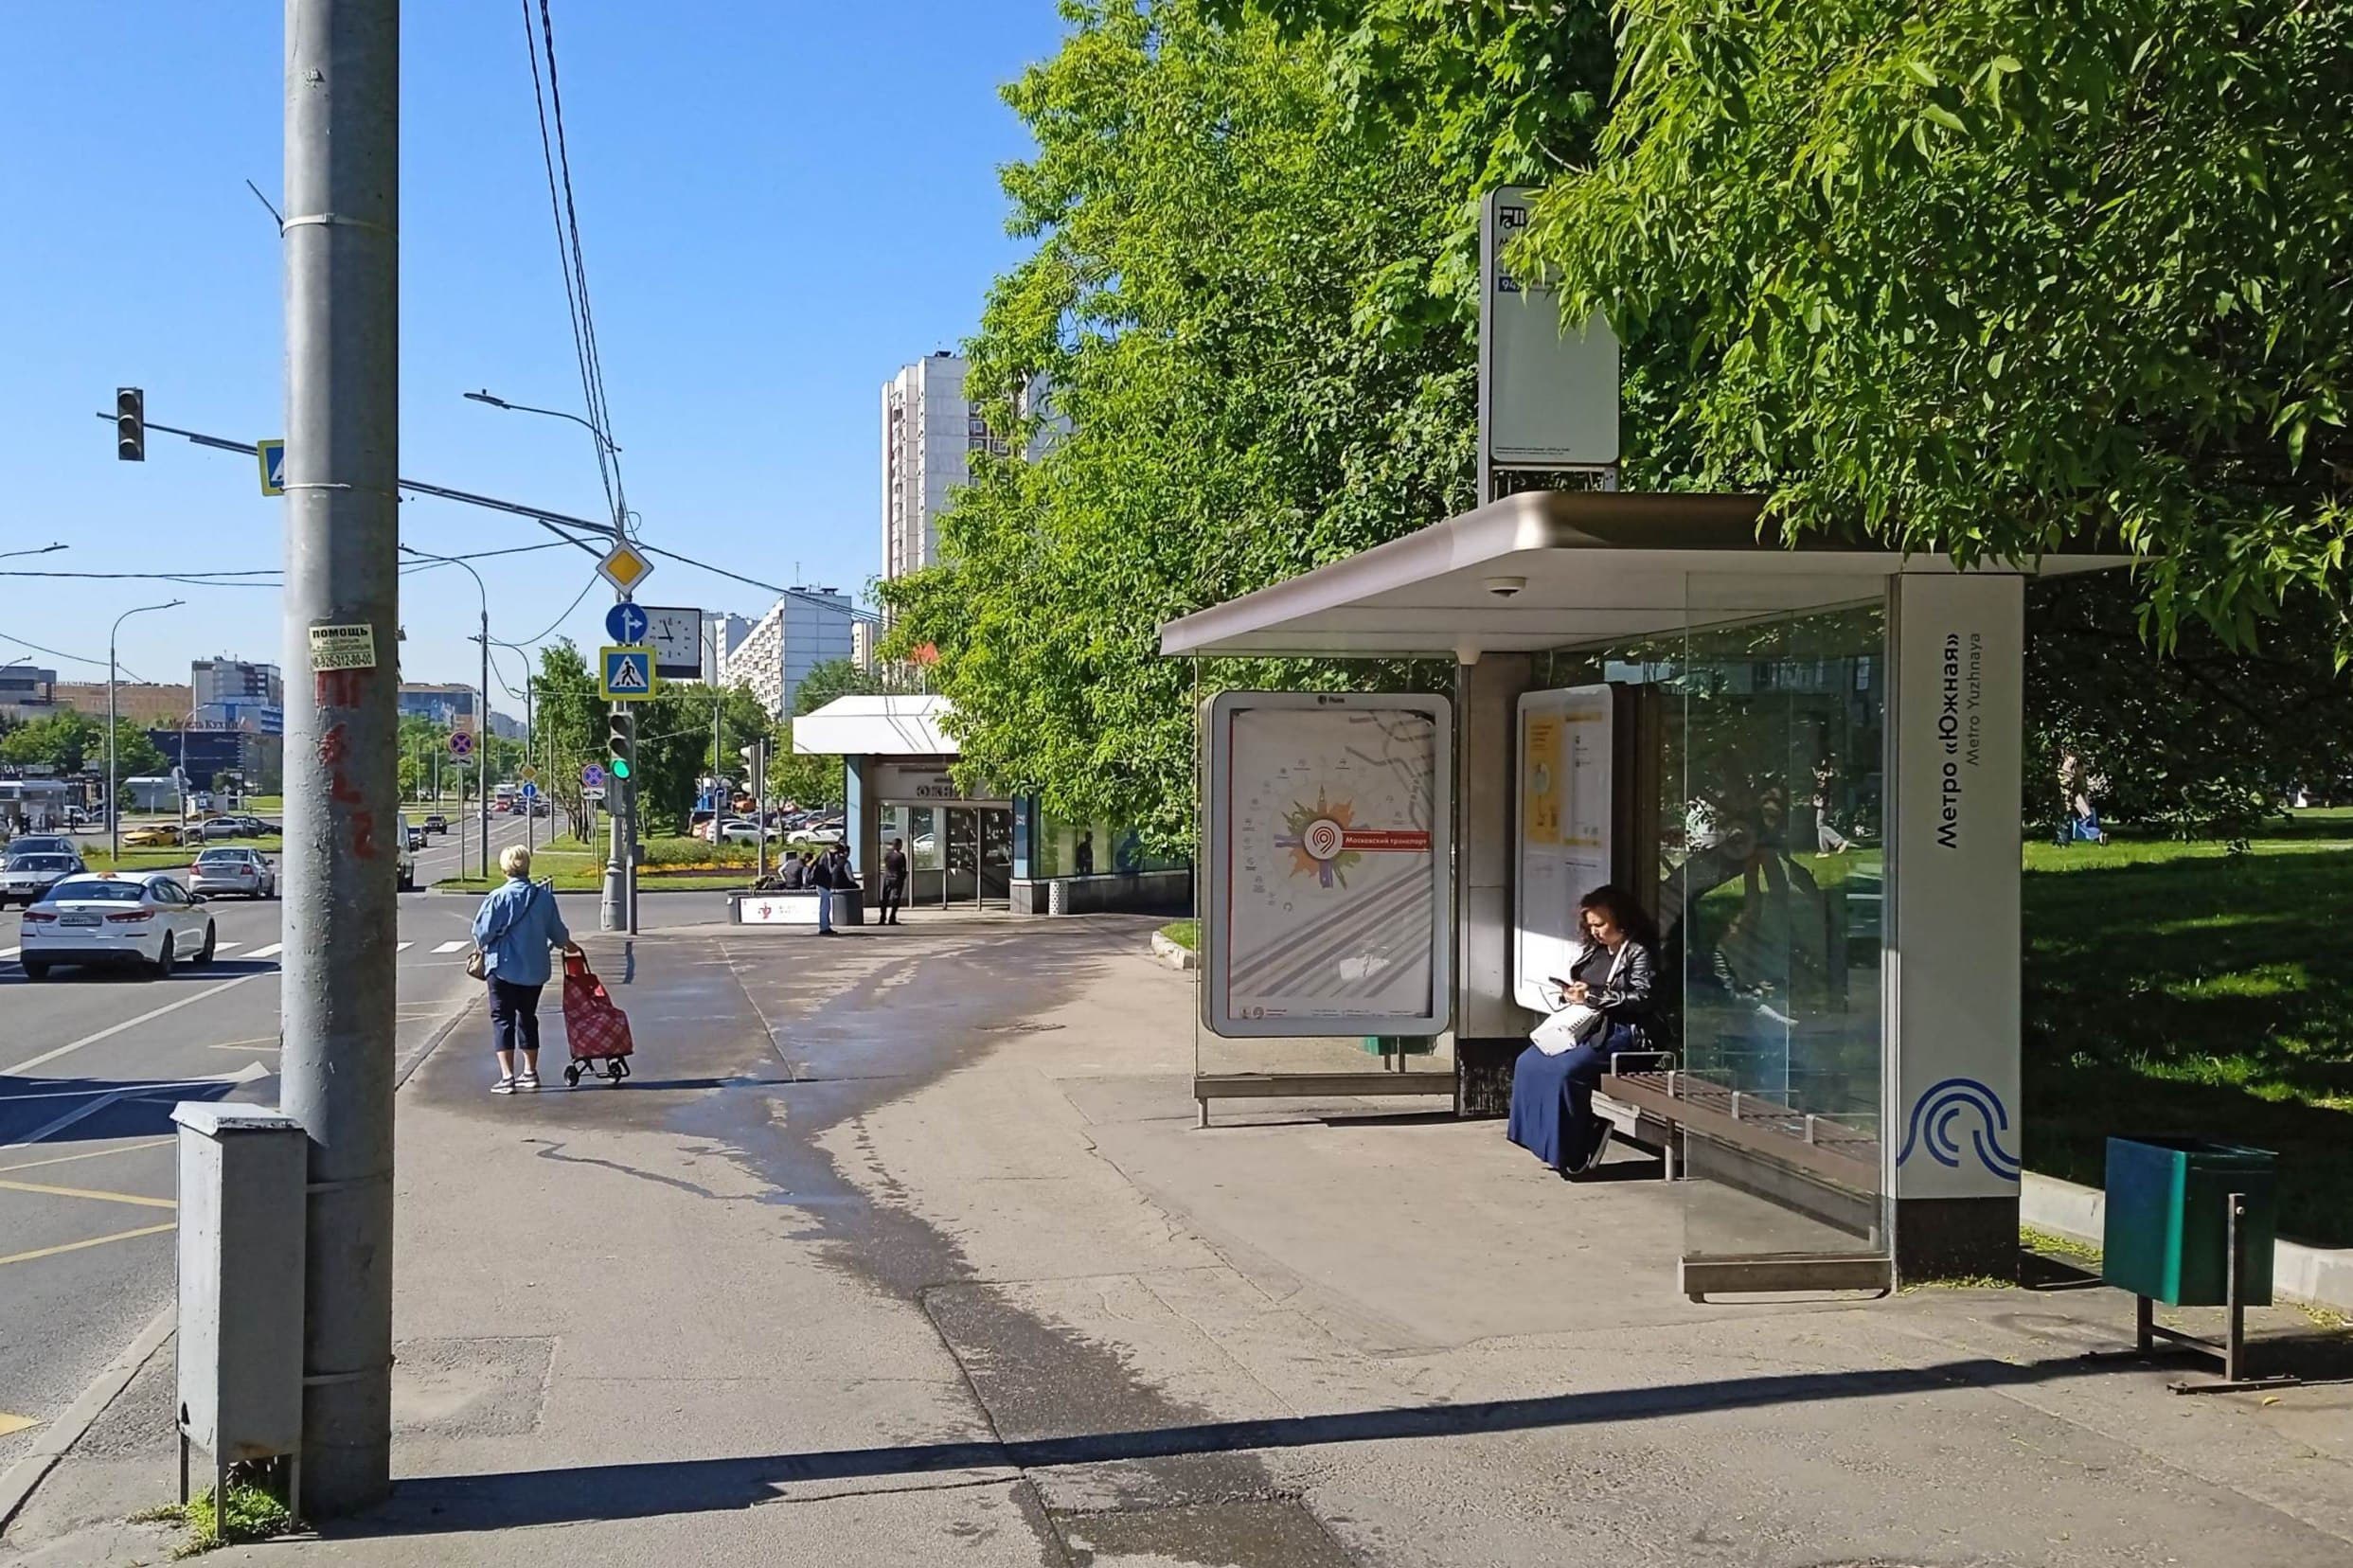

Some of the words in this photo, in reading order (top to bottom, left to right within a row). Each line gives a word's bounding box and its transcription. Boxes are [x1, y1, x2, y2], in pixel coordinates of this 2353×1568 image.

[1939, 633, 1958, 755] «Южная»
[1967, 633, 1982, 709] Yuzhnaya
[1967, 715, 1980, 766] Metro
[1346, 836, 1389, 845] Московский
[1390, 837, 1427, 846] транспорт
[1937, 762, 1961, 848] Метро
